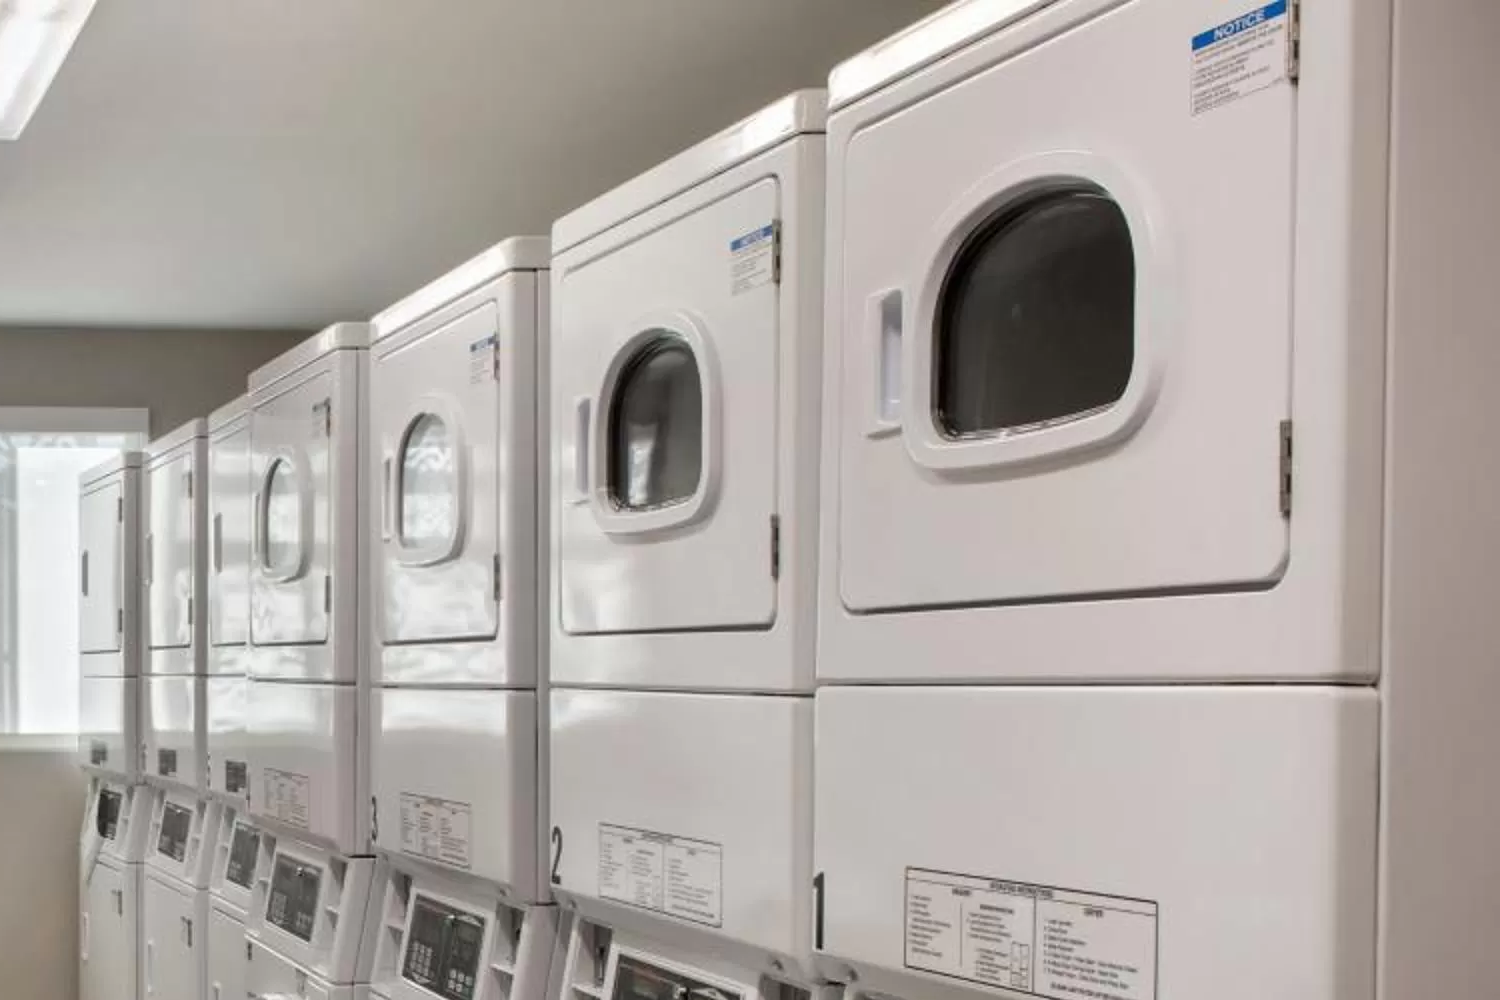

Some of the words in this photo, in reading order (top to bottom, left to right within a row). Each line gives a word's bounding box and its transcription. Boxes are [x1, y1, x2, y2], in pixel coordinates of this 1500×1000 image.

[1213, 10, 1266, 41] NOTICE
[551, 825, 563, 885] 2
[813, 871, 825, 950] 1
